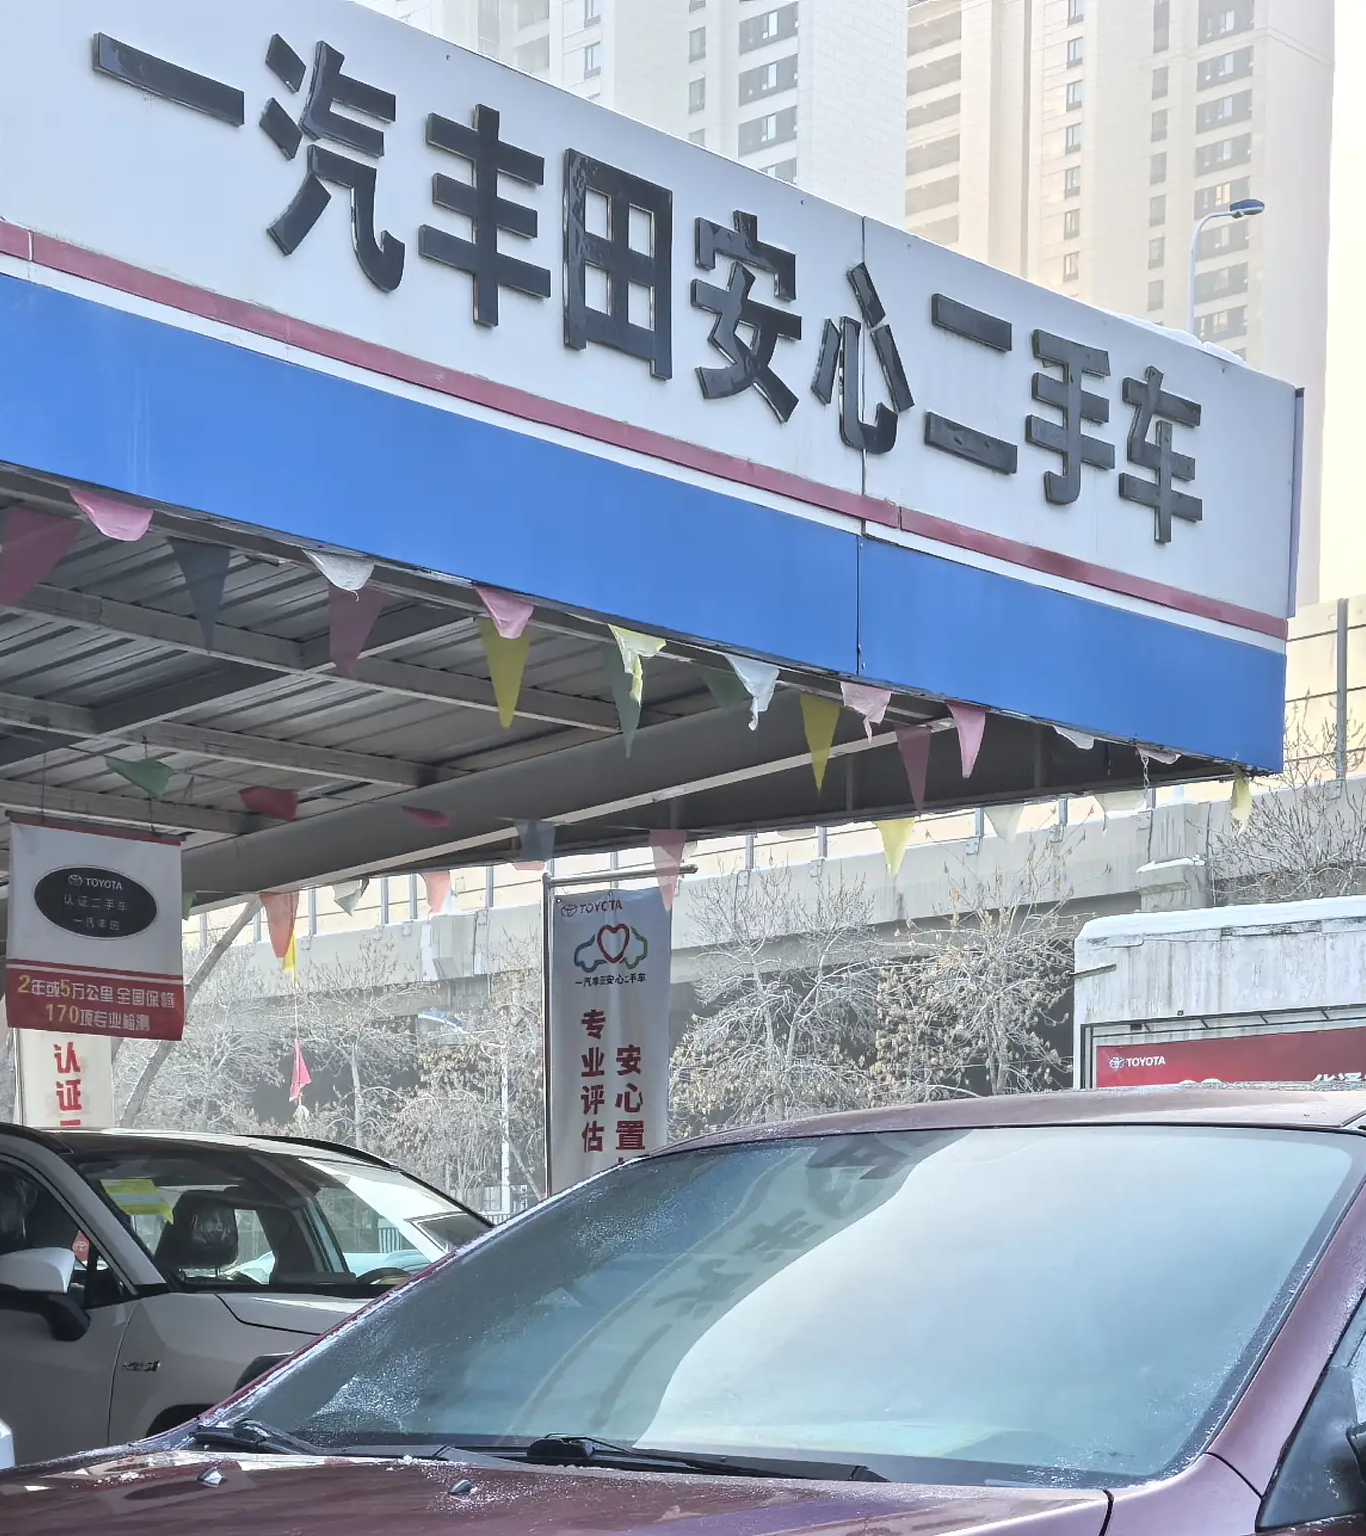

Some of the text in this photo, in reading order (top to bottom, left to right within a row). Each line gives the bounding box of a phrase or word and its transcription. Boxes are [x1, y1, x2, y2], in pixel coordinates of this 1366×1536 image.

[92, 31, 1204, 544] 一汽丰田安心二手车
[85, 877, 123, 892] TOYOTA
[579, 900, 623, 914] TOYOTA
[17, 974, 114, 1003] 2年或5万公里
[1125, 1055, 1167, 1068] TOYOTA
[580, 1009, 607, 1154] 专业评估
[614, 1044, 646, 1164] 安心置
